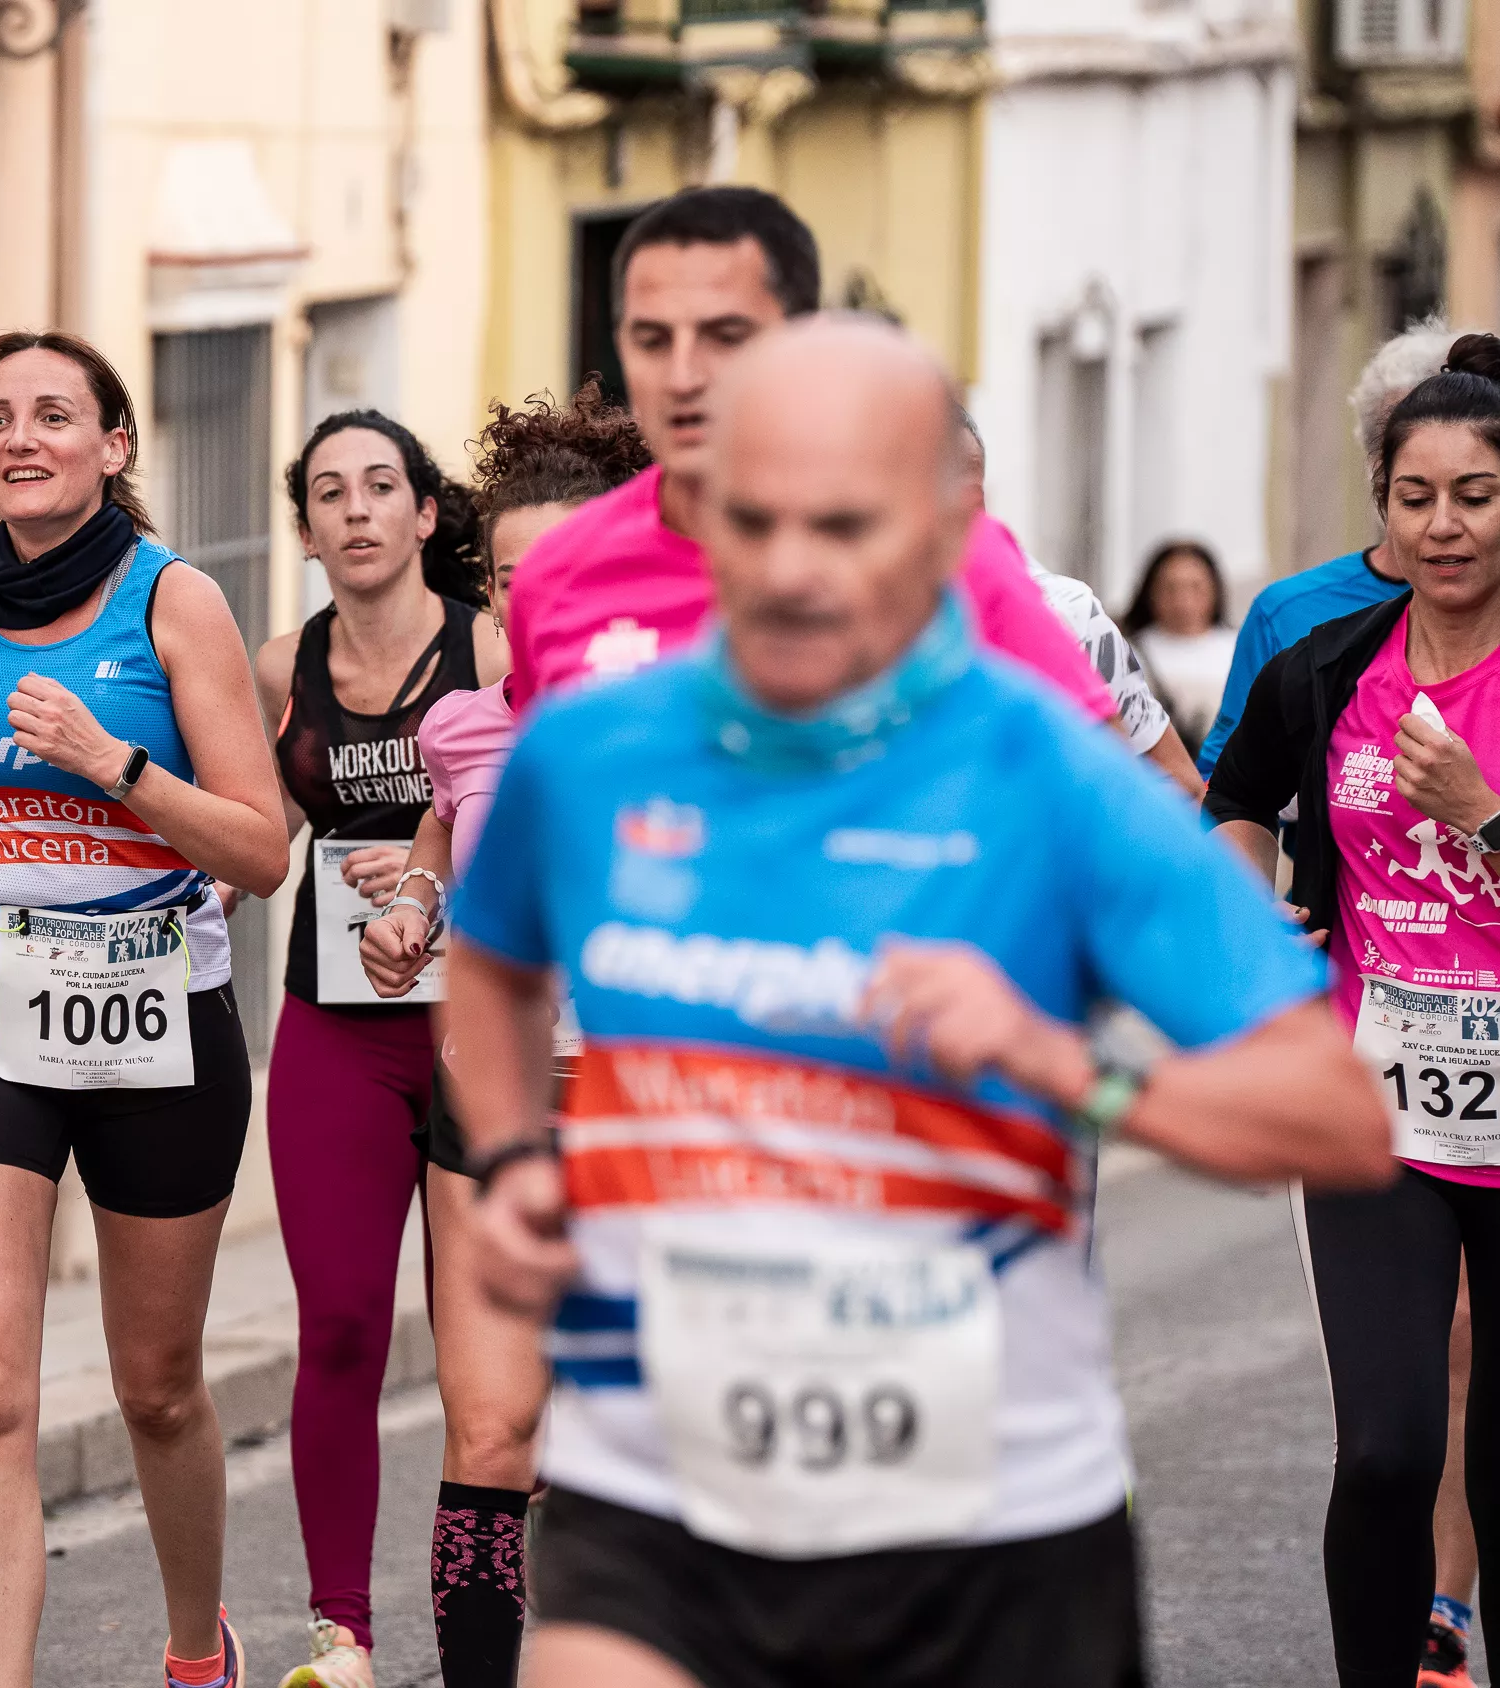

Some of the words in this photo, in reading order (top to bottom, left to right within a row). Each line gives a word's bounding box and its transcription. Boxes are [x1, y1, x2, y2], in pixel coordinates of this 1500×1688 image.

[1360, 743, 1381, 757] XXV
[1343, 751, 1394, 775] CARRERA
[1340, 766, 1394, 785] POPULAR
[333, 774, 431, 806] EVERYONE
[1333, 782, 1390, 803] LUCENA
[1418, 901, 1449, 922] KM
[7, 914, 44, 926] CIRITO
[46, 918, 93, 930] PROVINCIAL
[95, 923, 106, 932] DE
[8, 922, 53, 936] CAERAS
[55, 928, 106, 941] POPULARES
[106, 917, 150, 941] 2024
[1395, 921, 1407, 933] LA
[50, 968, 66, 977] XXV
[67, 970, 81, 979] C.P.
[82, 971, 110, 980] CIUDAD
[111, 970, 120, 979] DE
[121, 967, 145, 977] LUCENA
[66, 980, 80, 989] POR
[94, 980, 129, 990] IGUALDAD
[1398, 989, 1445, 1004] PROVINCIAL
[1447, 996, 1458, 1006] DE
[1405, 1000, 1458, 1015] POPULARES
[1406, 1011, 1415, 1019] DE
[29, 988, 168, 1046] 1006
[1402, 1041, 1418, 1050] XXV
[1419, 1044, 1434, 1052] C.P.
[1435, 1045, 1465, 1055] CIUDAD
[1466, 1048, 1478, 1056] DE
[1479, 1049, 1500, 1057] LUCE
[38, 1054, 64, 1065] MARIA
[66, 1059, 102, 1067] ARACELI
[104, 1058, 124, 1067] RUIZ
[125, 1055, 155, 1065] MUÑOZ
[1419, 1054, 1434, 1062] POR
[1436, 1056, 1447, 1064] LA
[1449, 1057, 1491, 1066] IGUALDAD
[1383, 1062, 1498, 1121] 132
[1413, 1127, 1448, 1139] SORAYA
[1449, 1133, 1472, 1142] CRUZ
[722, 1379, 920, 1473] 999
